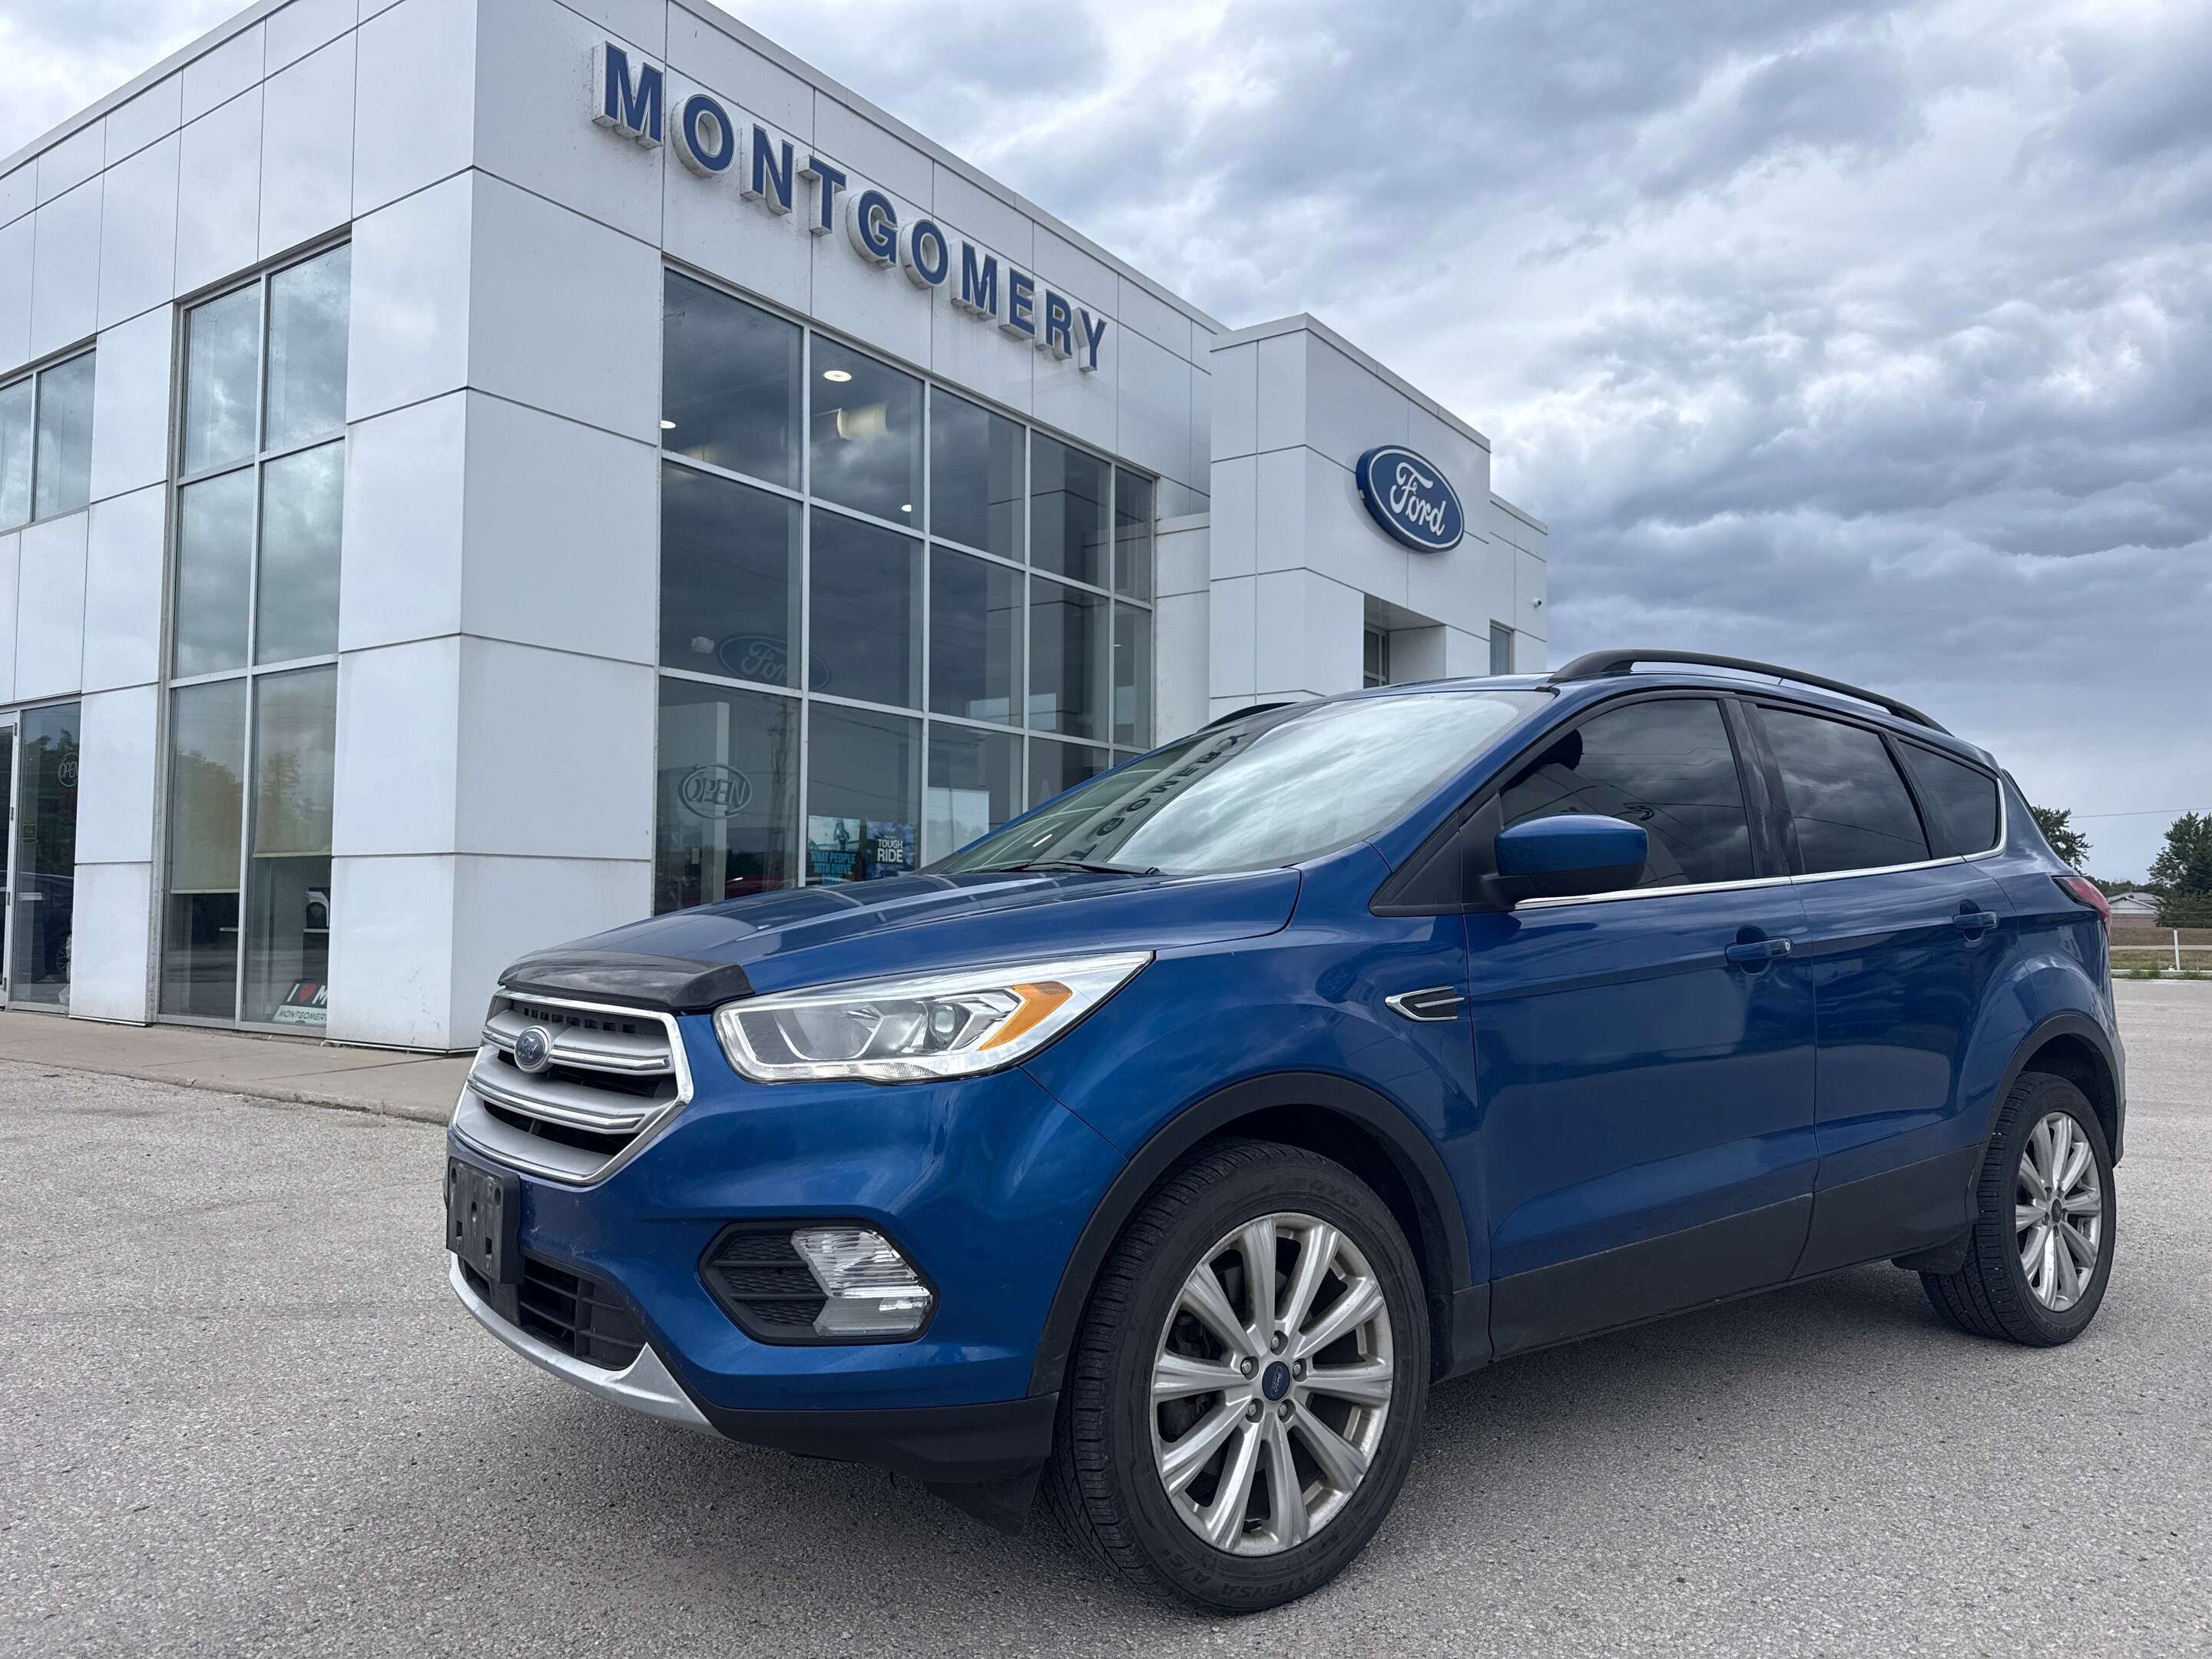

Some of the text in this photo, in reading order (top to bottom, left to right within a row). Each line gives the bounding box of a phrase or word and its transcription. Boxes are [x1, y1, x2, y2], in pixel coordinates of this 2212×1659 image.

[593, 41, 1108, 373] MONTGOMERY
[1389, 462, 1447, 536] Ford
[687, 777, 747, 806] OPEN
[877, 838, 903, 849] TOUGH
[810, 850, 856, 864] WHAT PEOPLE
[877, 847, 903, 863] RIDE
[286, 982, 300, 1002] I
[278, 1009, 327, 1022] MONTGOMER
